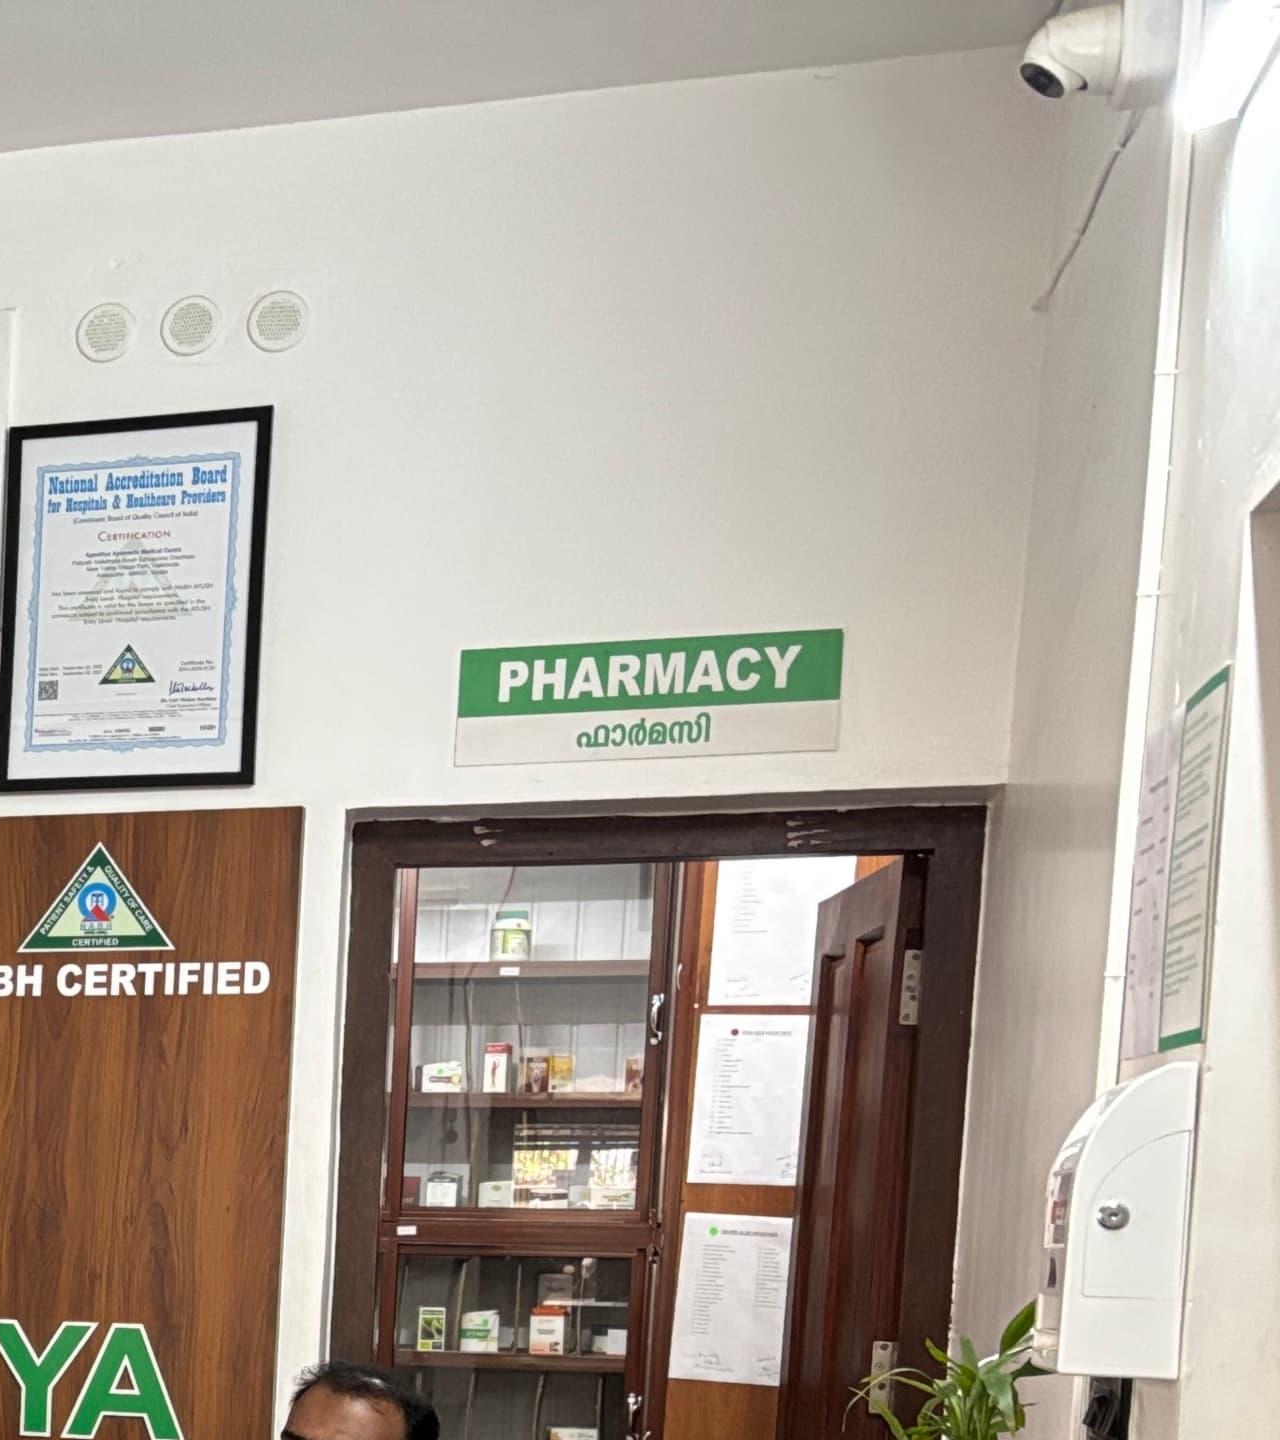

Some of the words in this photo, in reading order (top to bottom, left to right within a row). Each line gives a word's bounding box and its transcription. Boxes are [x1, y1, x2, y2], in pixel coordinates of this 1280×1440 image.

[48, 473, 98, 495] National
[105, 468, 184, 491] Accreditation
[192, 464, 227, 486] Board
[48, 499, 61, 514] for
[66, 496, 107, 515] Hospitals
[113, 495, 121, 510] &
[126, 493, 176, 508] Healthcare
[181, 488, 226, 505] Providers
[498, 645, 802, 703] PHARMACY
[576, 712, 712, 749] ഫാർമസി
[40, 904, 67, 935] PATIENT
[64, 874, 89, 903] SAFETY
[104, 865, 129, 900] QUALITY
[127, 898, 138, 910] OF
[134, 909, 154, 933] CARE
[72, 938, 119, 947] CERTIFIED
[56, 961, 271, 997] CERTIFIED
